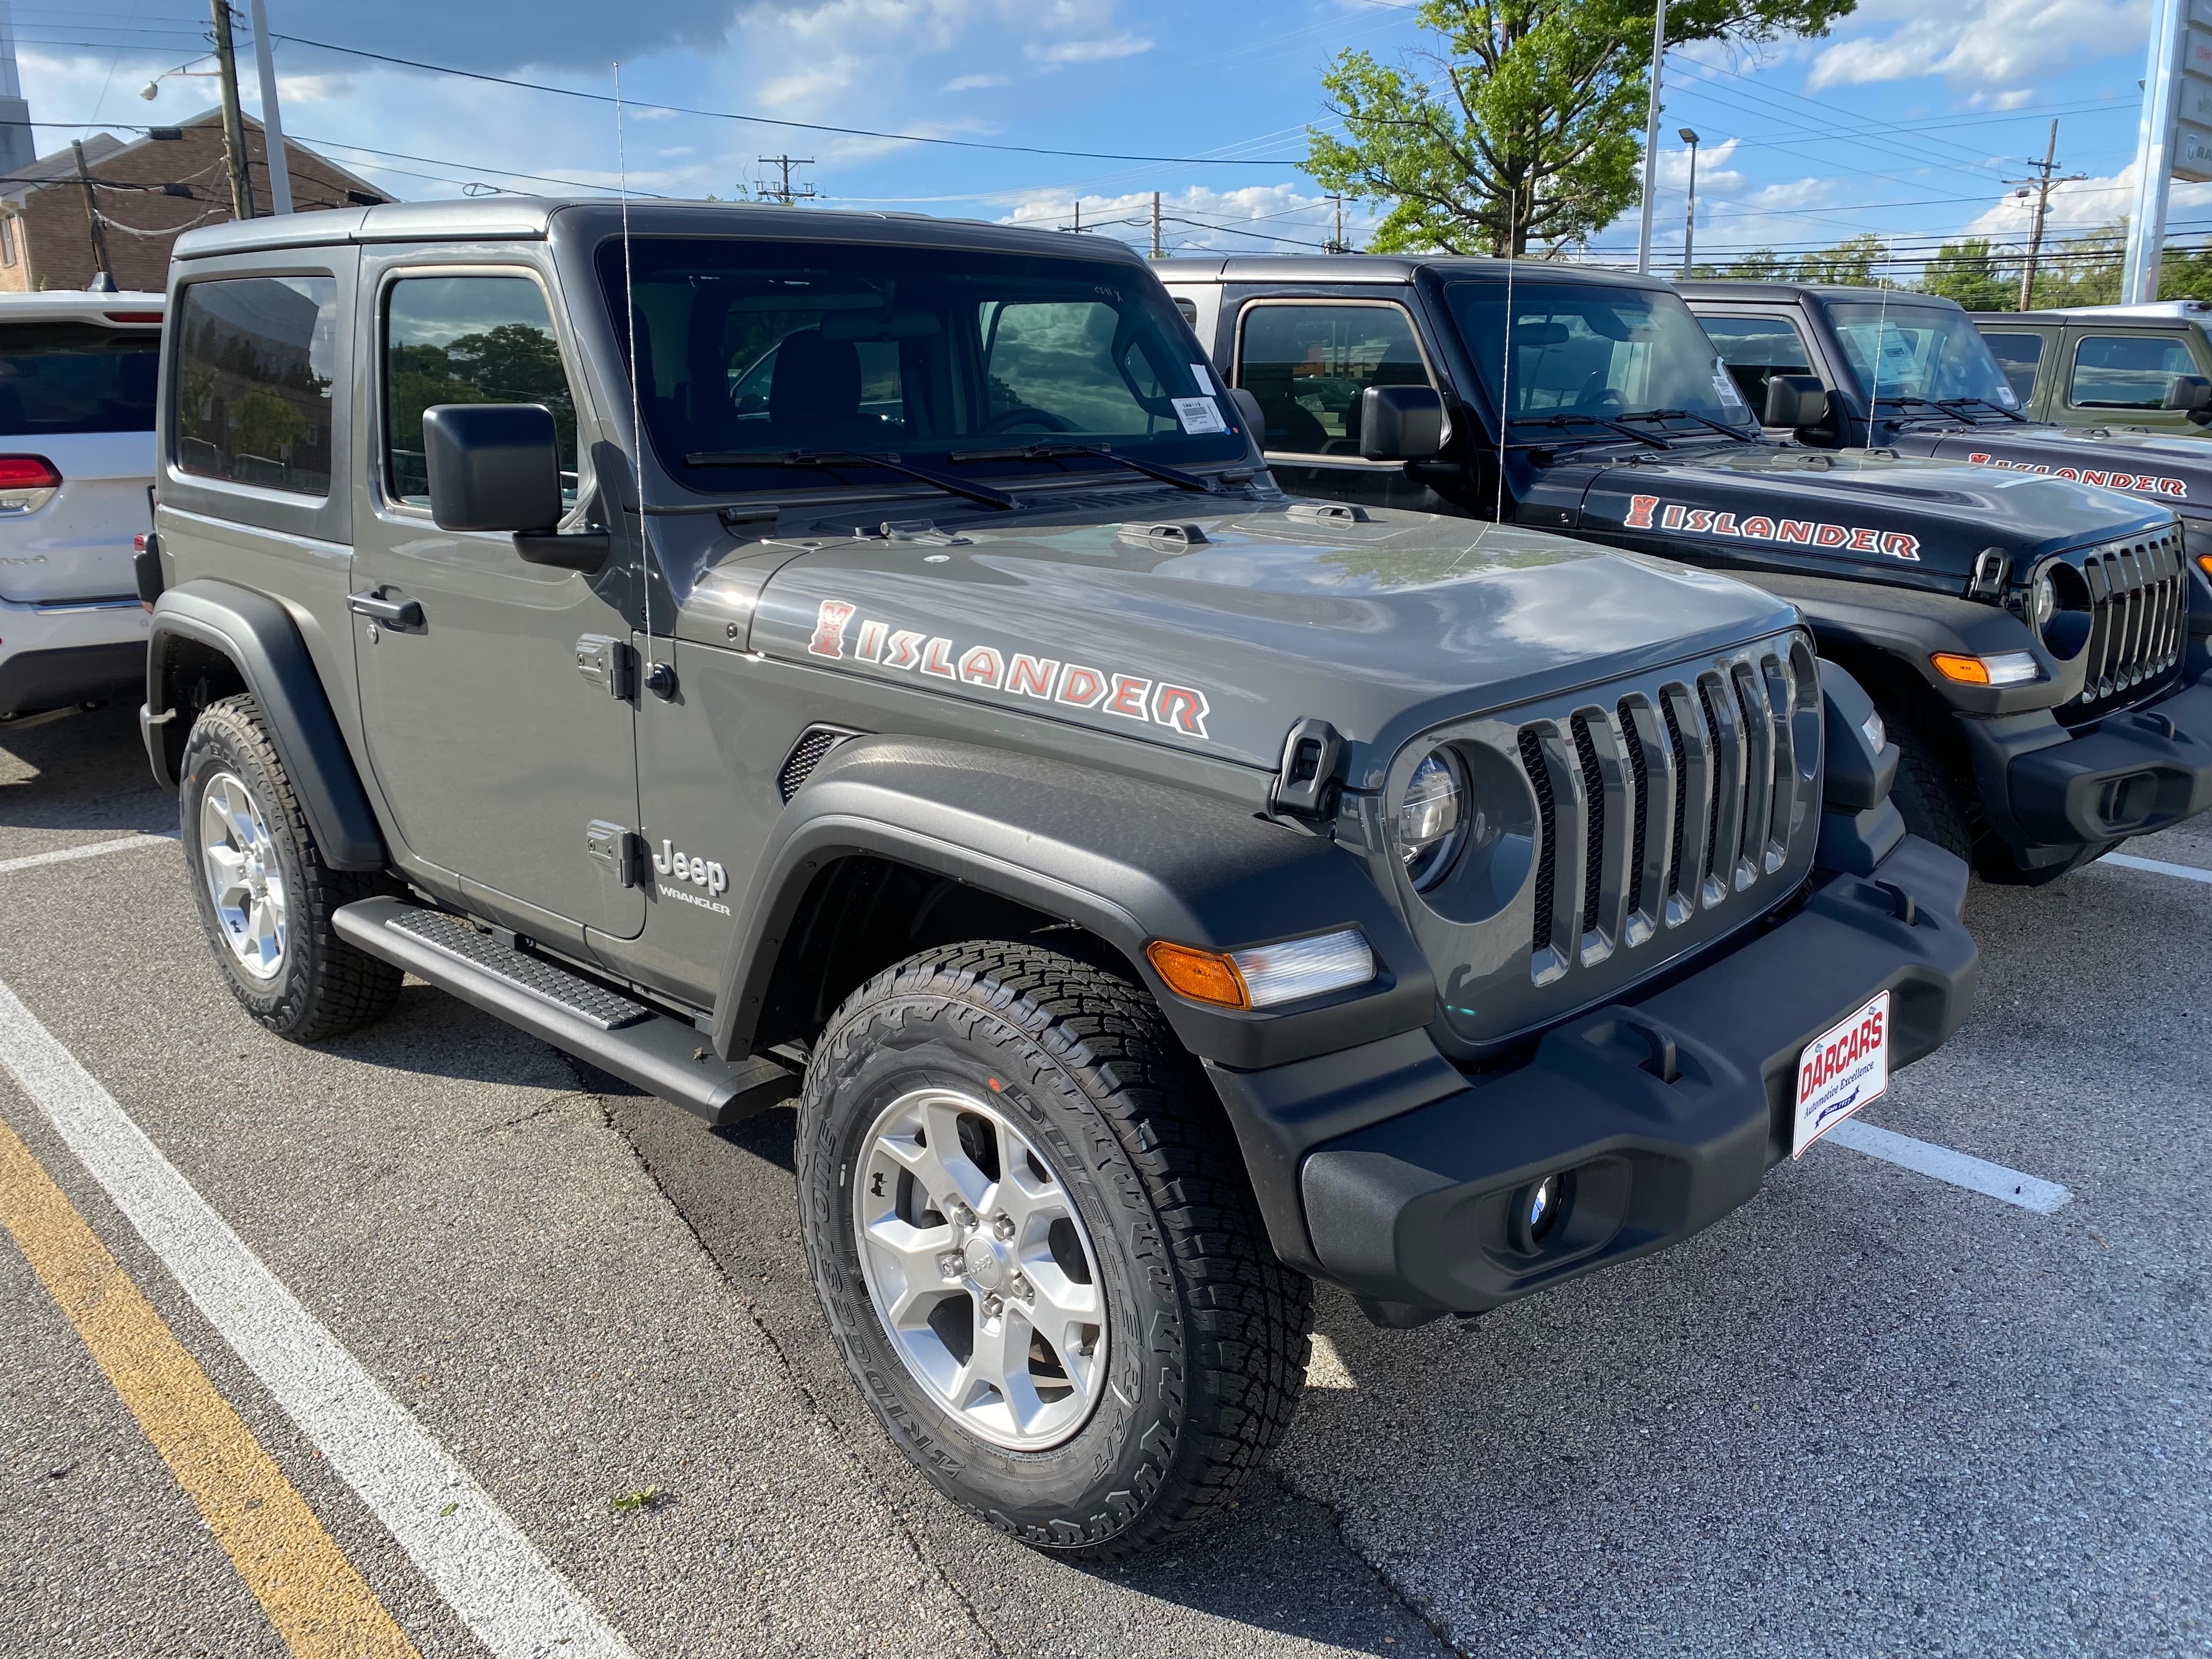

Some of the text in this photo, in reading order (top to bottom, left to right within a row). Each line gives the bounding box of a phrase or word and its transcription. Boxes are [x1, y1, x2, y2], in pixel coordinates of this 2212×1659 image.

[1661, 505, 1921, 561] ISLANDER
[854, 619, 1210, 740] ISLANDER
[653, 839, 728, 897] Jeep
[658, 884, 731, 916] WRANGLER
[1800, 1011, 1883, 1105] DARCARS
[1804, 1060, 1875, 1119] Automotive Excellence
[812, 1116, 966, 1480] BRIDGESTONE
